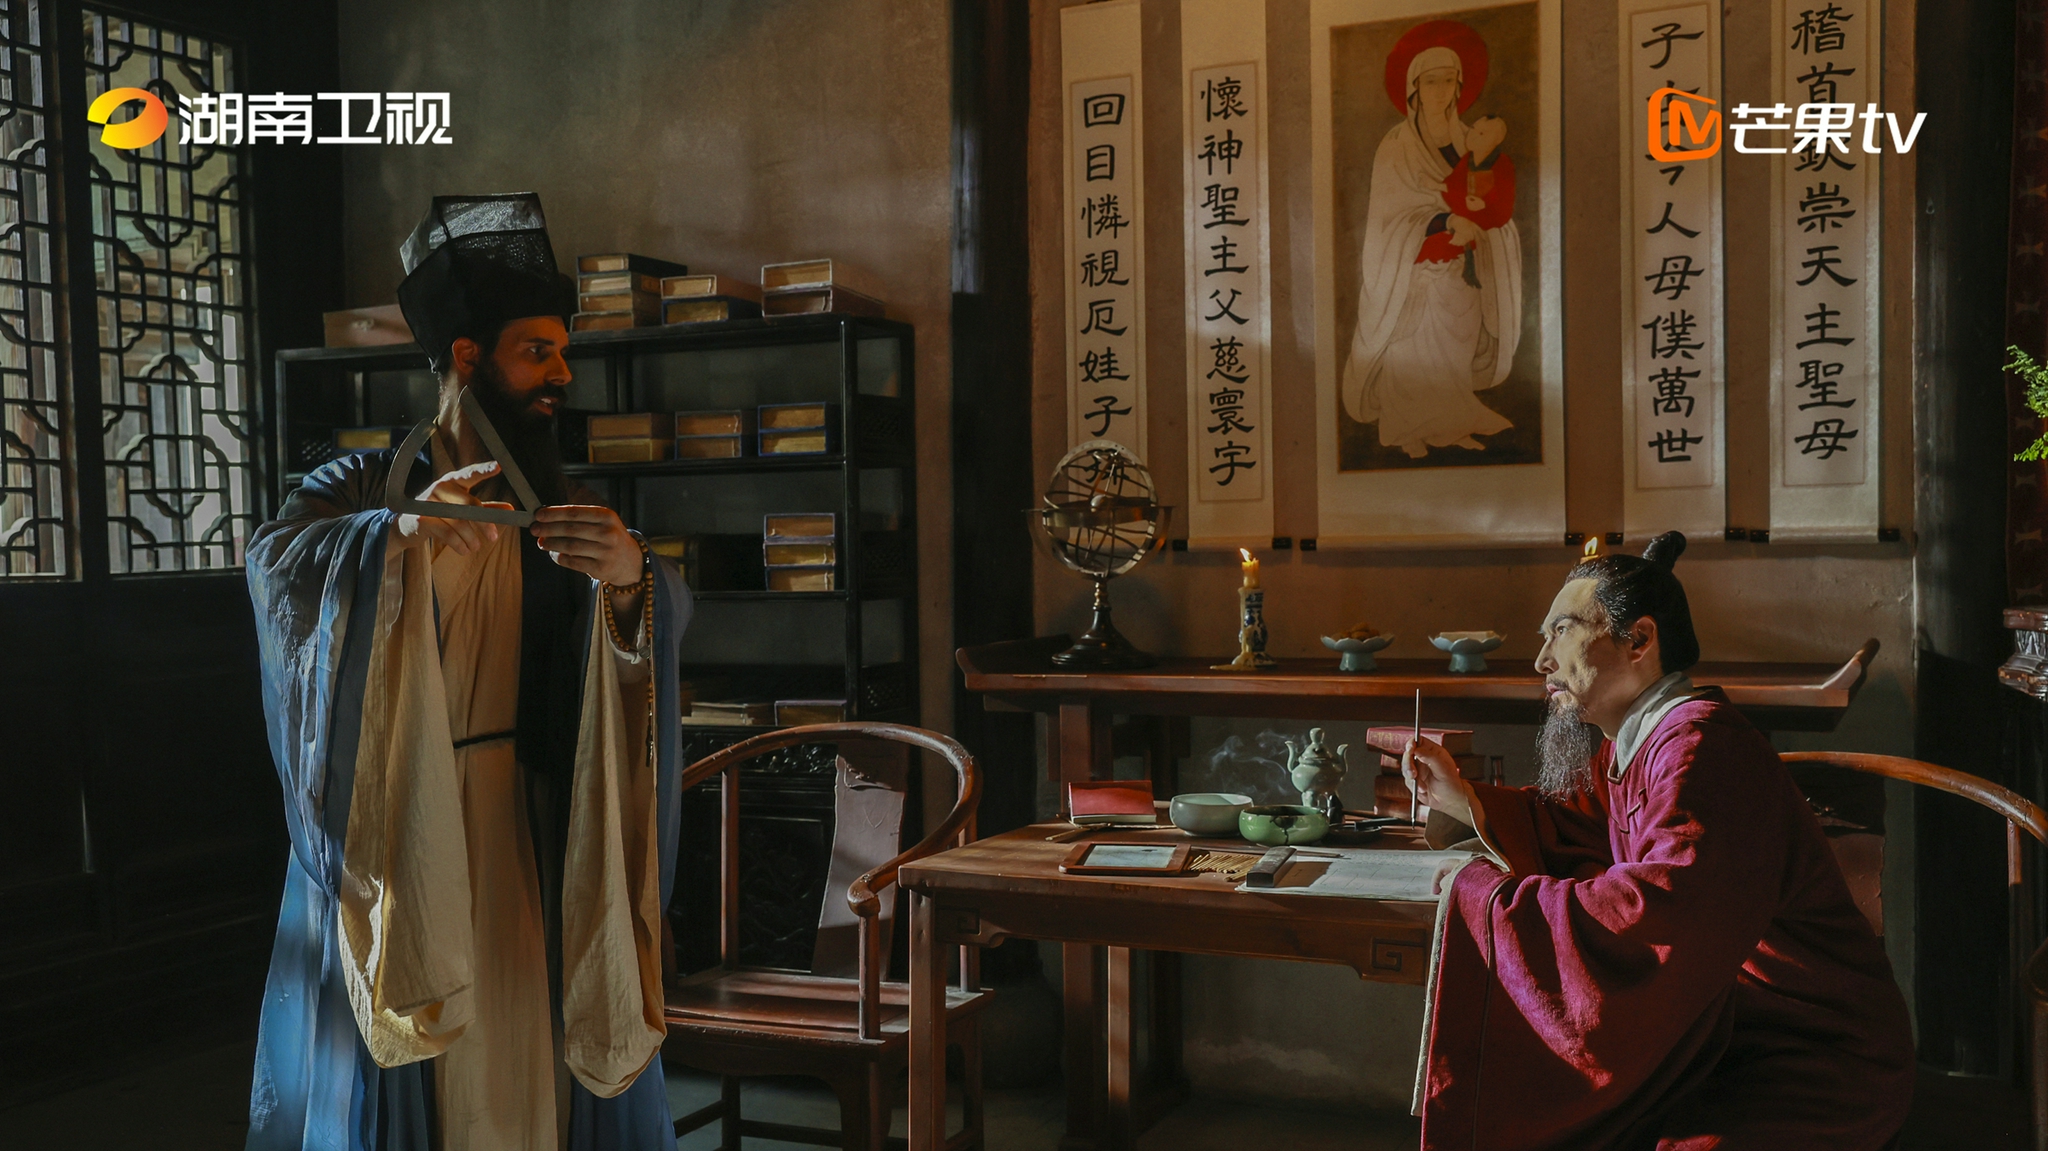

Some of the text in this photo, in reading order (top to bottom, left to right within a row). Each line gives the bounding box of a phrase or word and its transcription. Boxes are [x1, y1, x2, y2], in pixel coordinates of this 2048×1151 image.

[1198, 77, 1256, 486] 懷神聖主父慈寰宇
